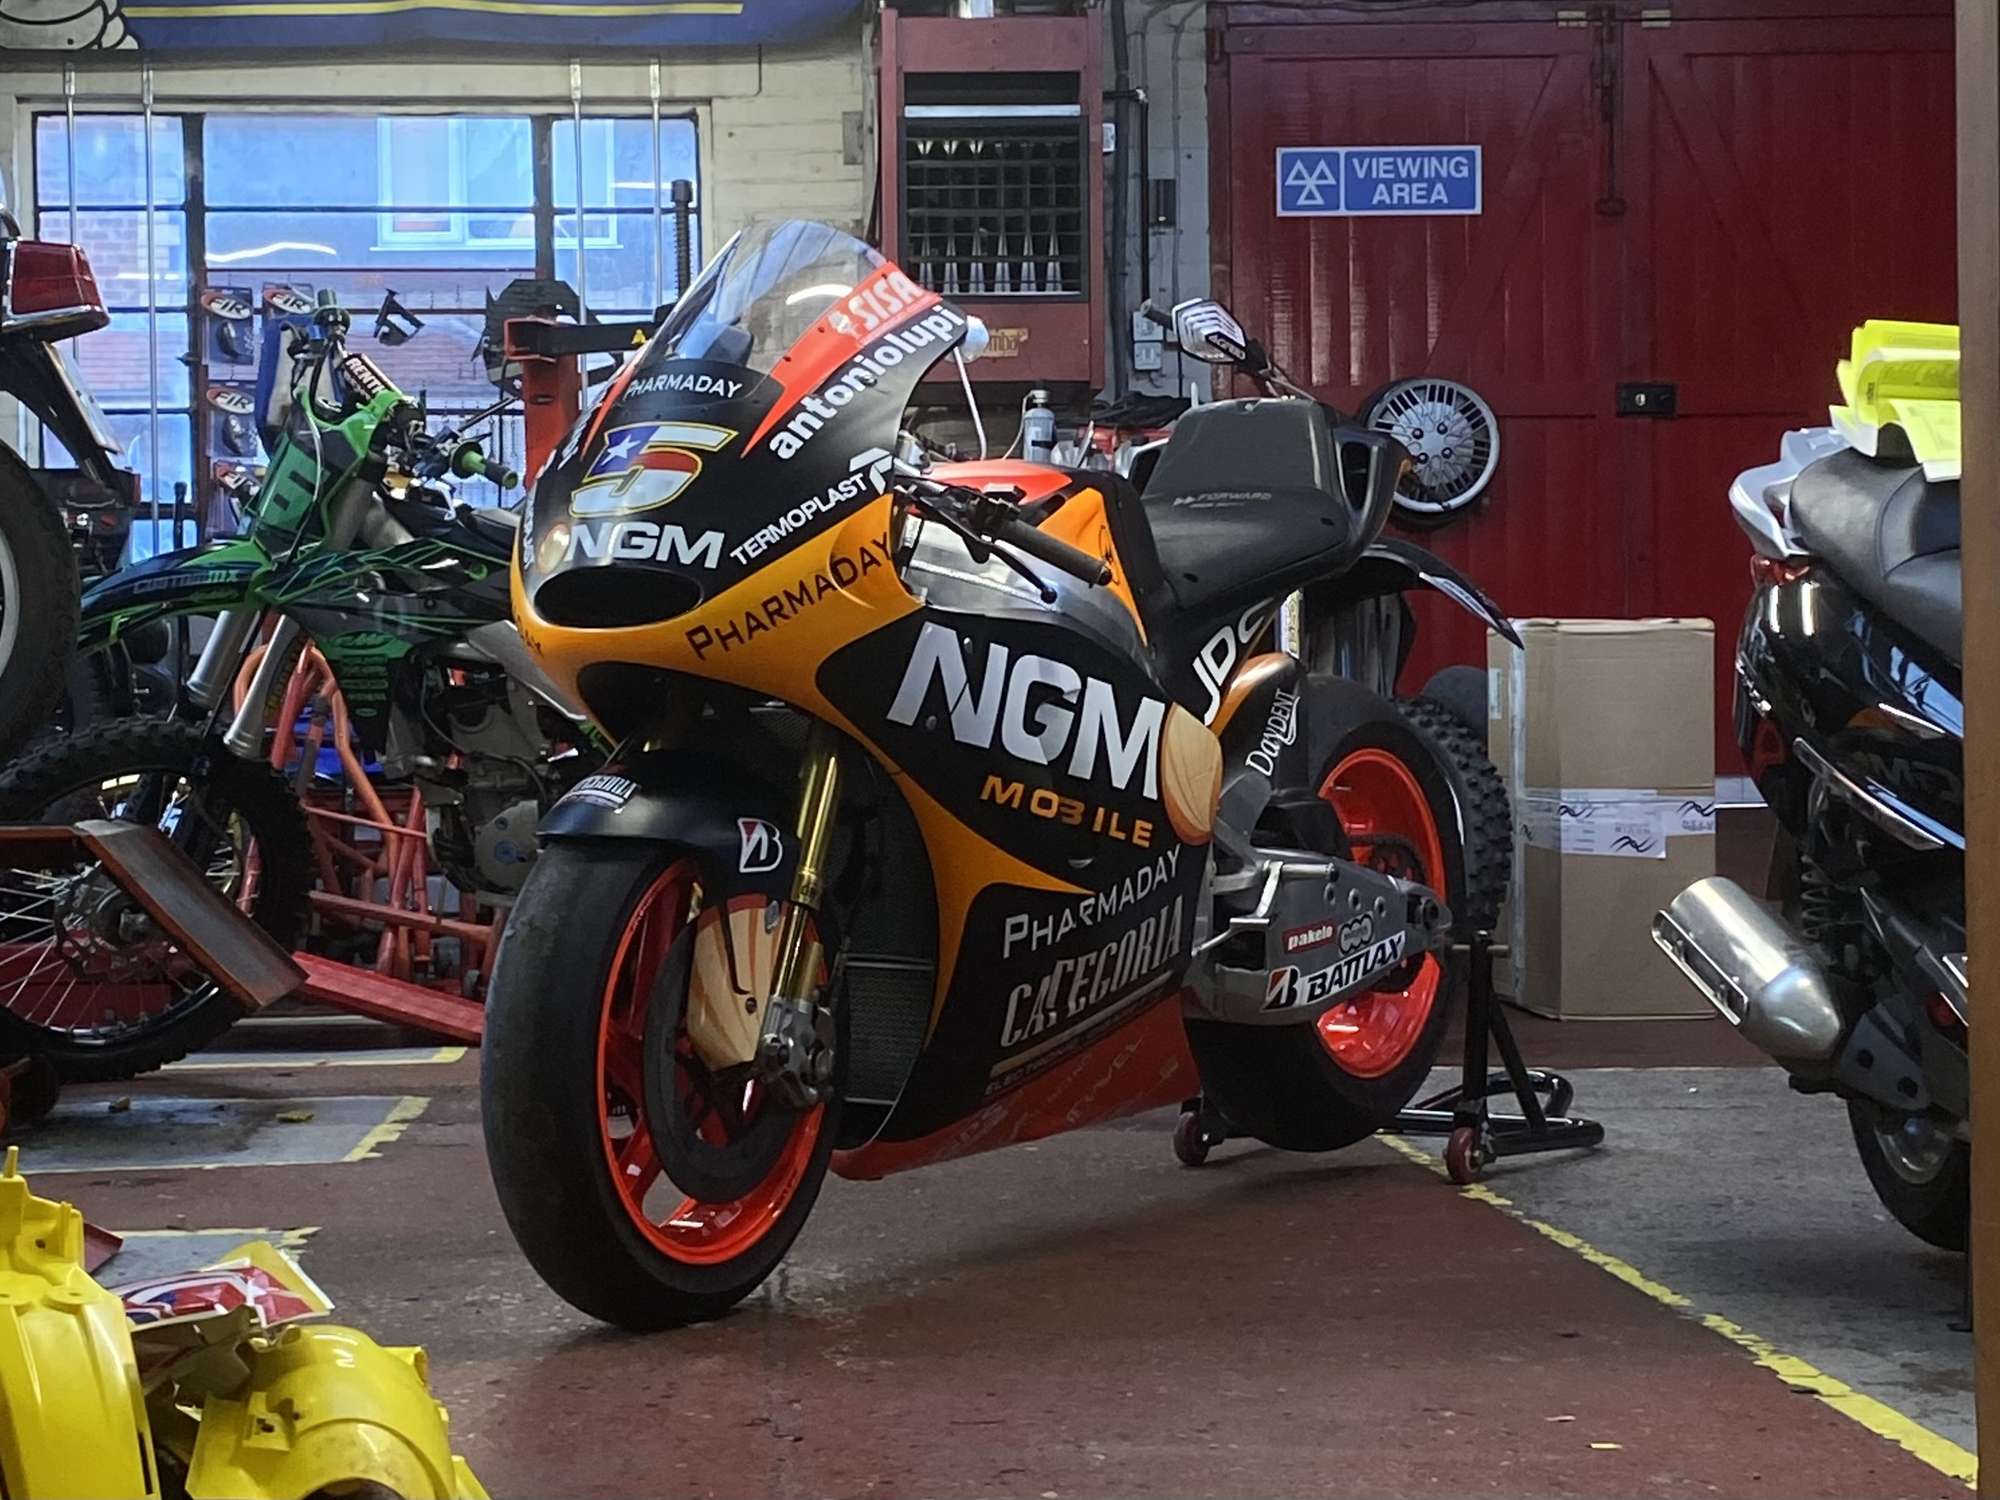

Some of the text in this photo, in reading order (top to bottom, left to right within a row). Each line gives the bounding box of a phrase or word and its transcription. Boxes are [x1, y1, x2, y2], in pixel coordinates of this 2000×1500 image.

[1352, 156, 1469, 179] VIEWING
[1371, 183, 1449, 205] AREA
[848, 270, 923, 332] SISA
[624, 373, 743, 400] PHARMADAY
[768, 304, 966, 460] antoniolupi
[570, 421, 739, 518] 5
[562, 521, 725, 570] NGM
[730, 473, 869, 566] TERMOPLAST
[685, 532, 893, 661] PHARMADAY
[886, 620, 1165, 801] NGM
[980, 775, 1153, 848] MOBILE
[1003, 843, 1181, 959] PHARMADAY
[1001, 894, 1183, 1048] CATEGORIA
[1306, 933, 1405, 1003] BATTLAX
